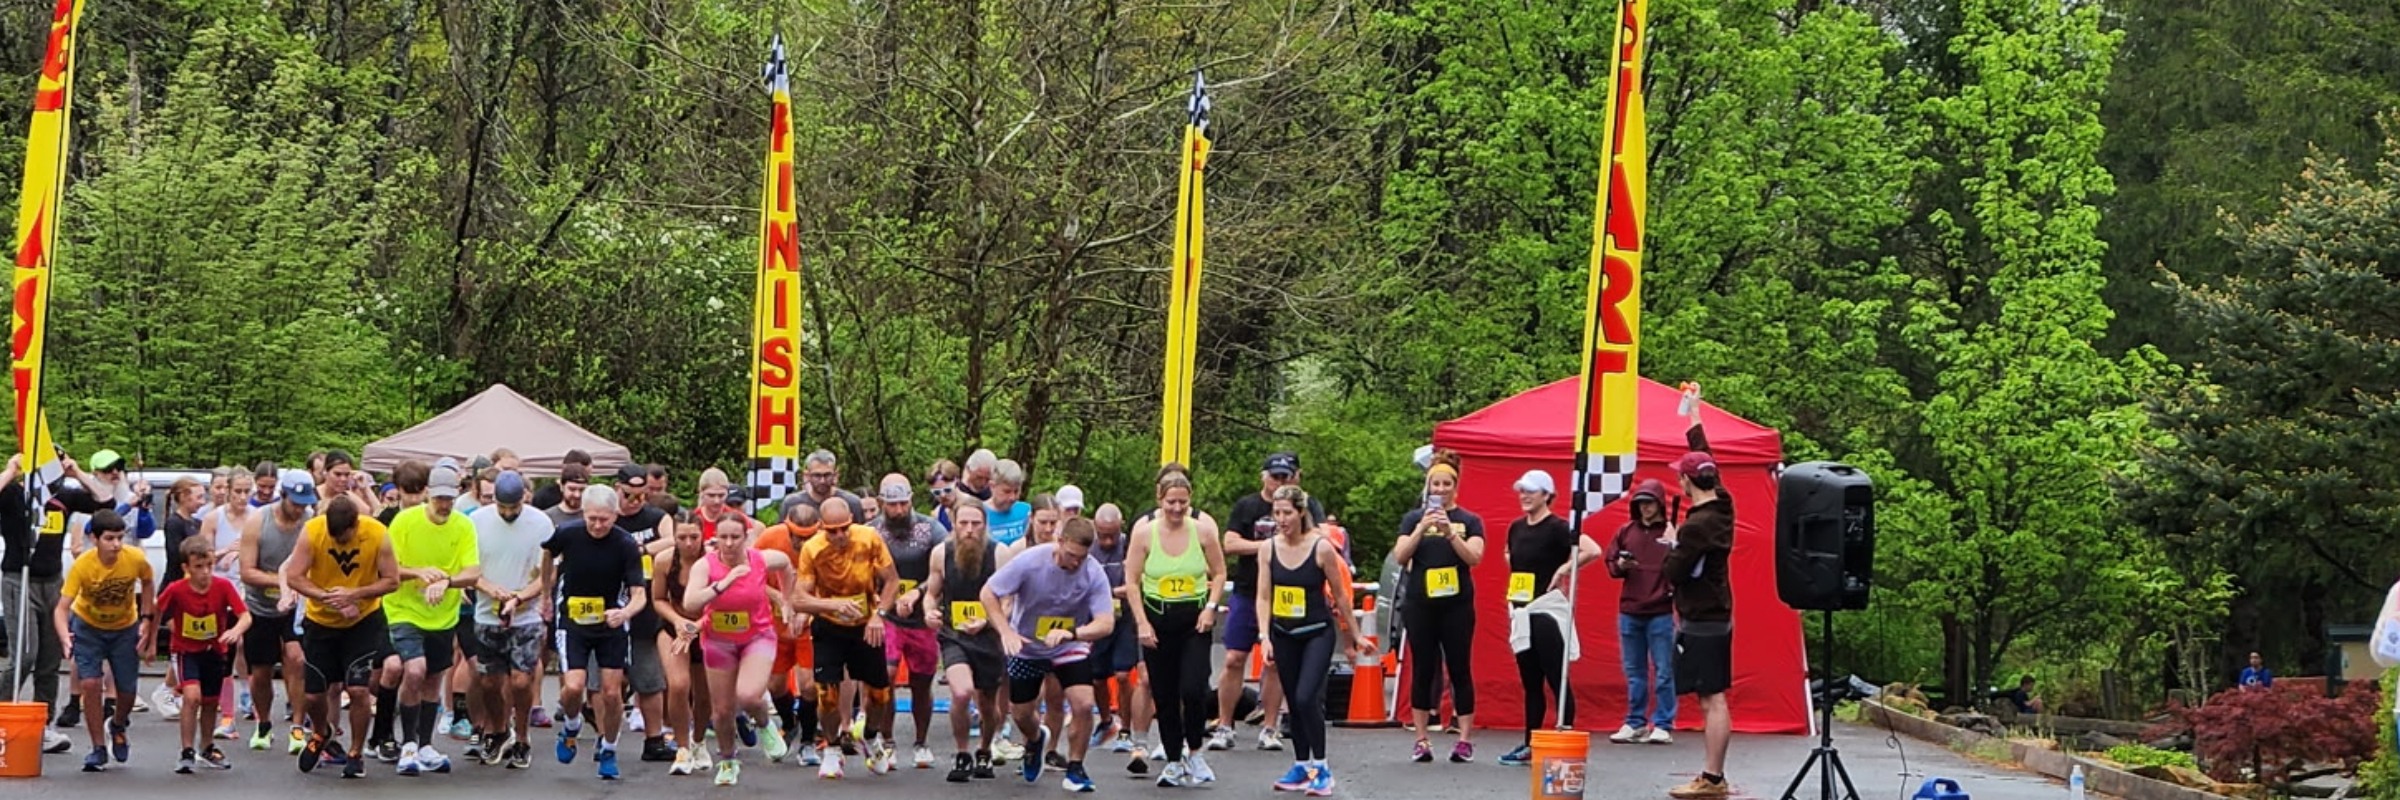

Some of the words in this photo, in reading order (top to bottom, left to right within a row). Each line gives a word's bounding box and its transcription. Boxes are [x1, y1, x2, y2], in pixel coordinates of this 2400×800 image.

[756, 101, 799, 446] FINISH
[1171, 579, 1184, 592] 12
[579, 602, 594, 615] 36
[723, 613, 739, 626] 70
